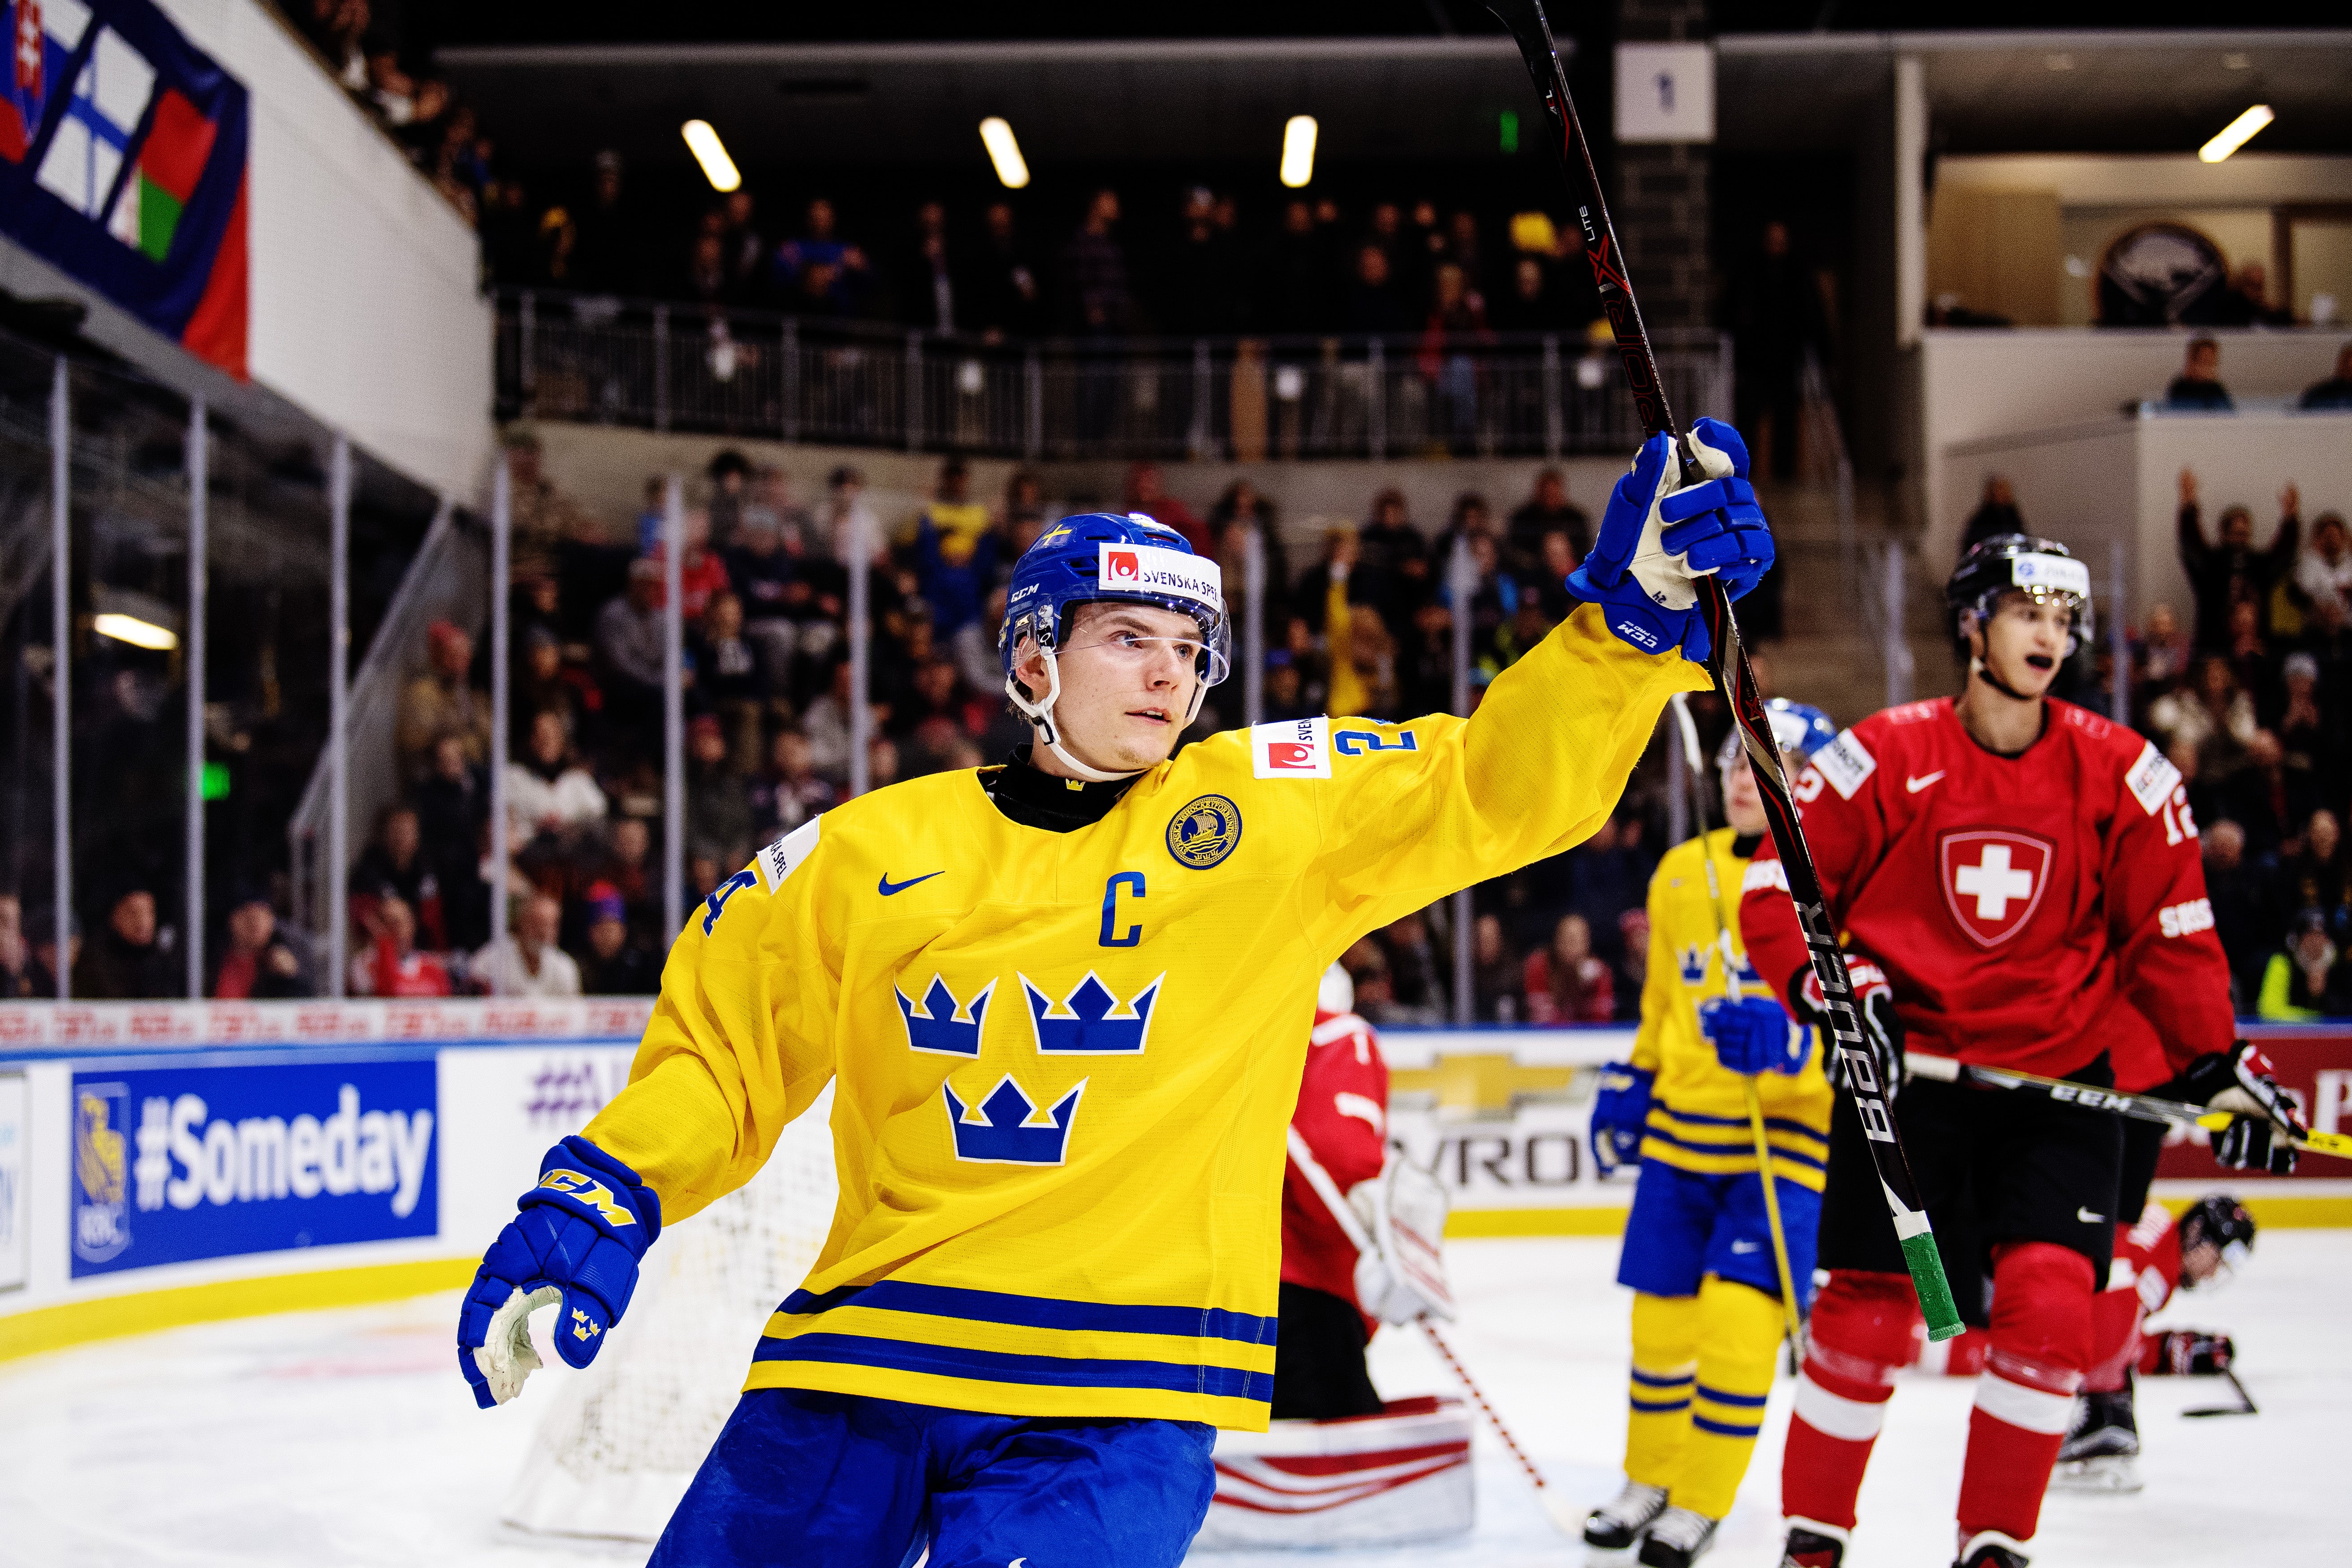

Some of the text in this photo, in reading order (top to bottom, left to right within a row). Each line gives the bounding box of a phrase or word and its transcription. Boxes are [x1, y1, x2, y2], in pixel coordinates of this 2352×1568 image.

[1579, 206, 1595, 242] LITE
[1010, 583, 1040, 603] CCM
[1144, 570, 1218, 603] SVENSKA SPEL
[1617, 623, 1657, 648] CCM
[1633, 626, 1651, 636] PRO
[1334, 718, 1418, 756] 2
[1174, 822, 1188, 855] SVENSKA
[773, 851, 787, 880] SPEL
[1099, 871, 1146, 948] C
[1793, 901, 1896, 1143] BAUER
[134, 1082, 435, 1219] #Someday
[539, 1168, 637, 1227] CM
